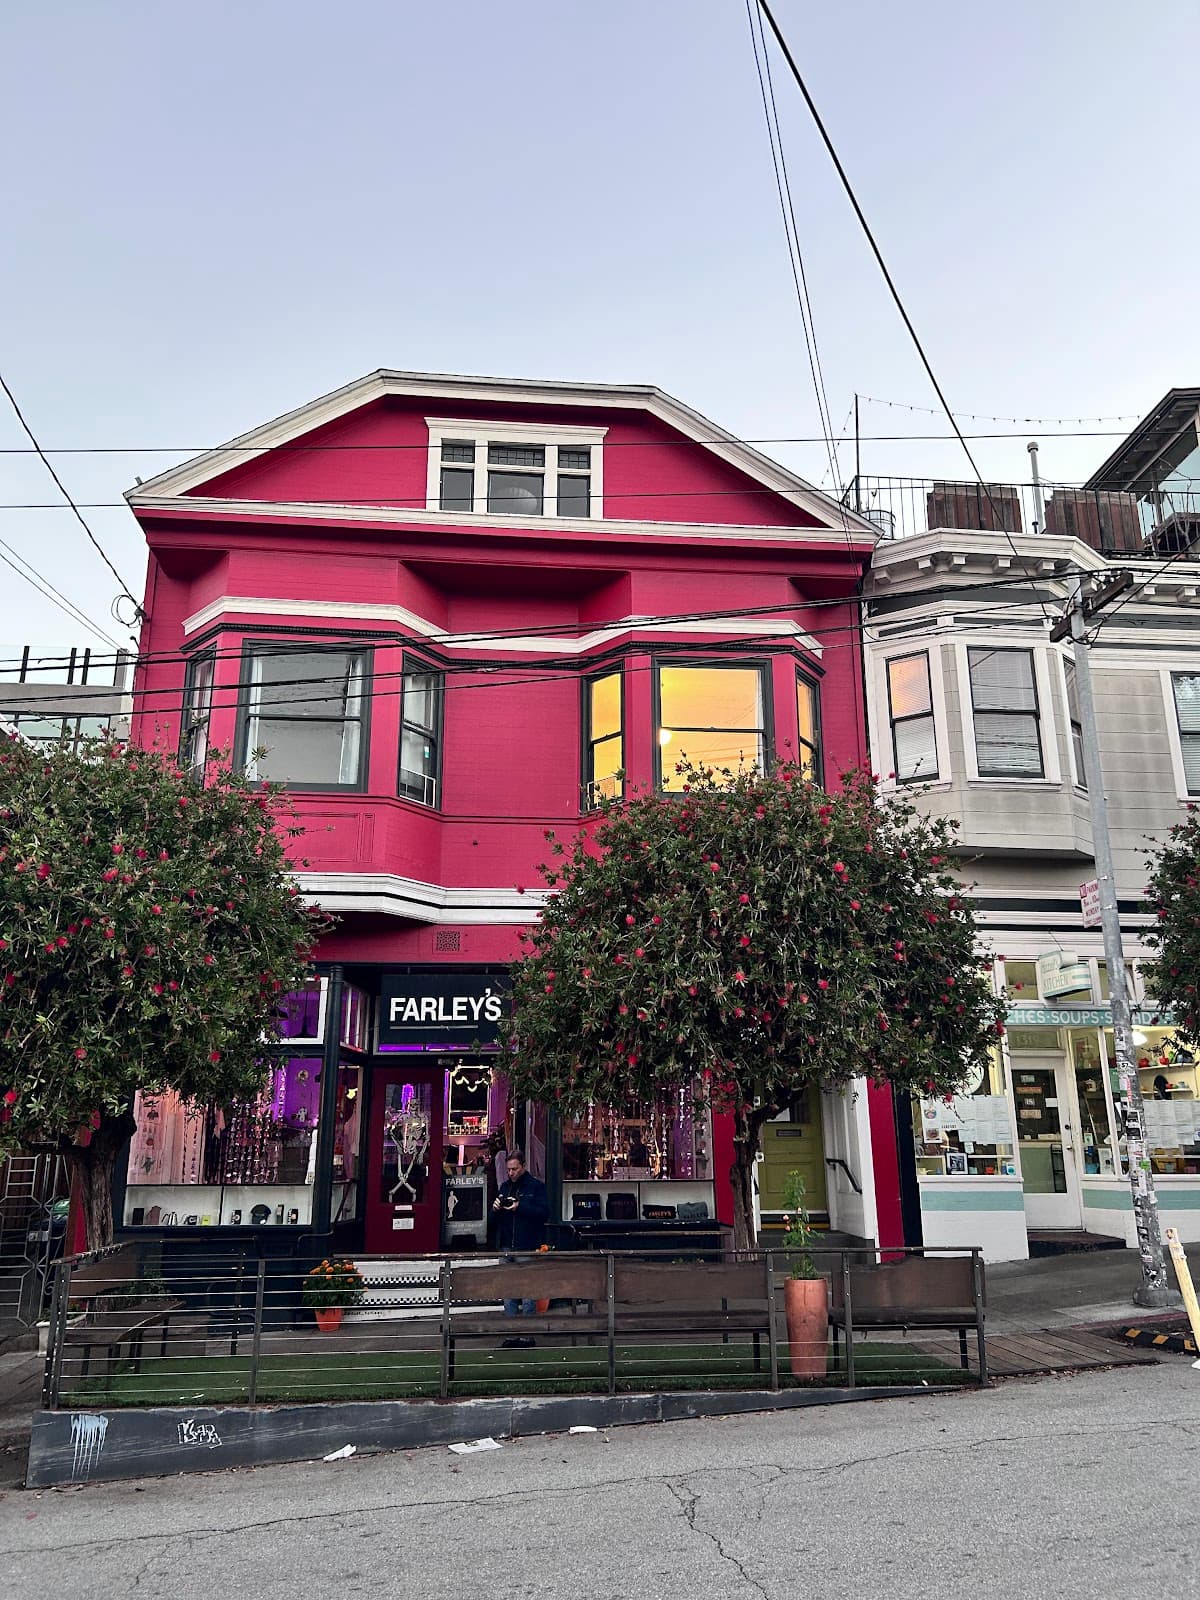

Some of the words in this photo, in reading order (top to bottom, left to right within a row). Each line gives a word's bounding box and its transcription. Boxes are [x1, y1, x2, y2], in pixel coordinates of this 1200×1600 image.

[390, 988, 501, 1021] FARLEY'S
[1051, 1010, 1099, 1024] SOUPS
[445, 1177, 484, 1185] FARLEY'S
